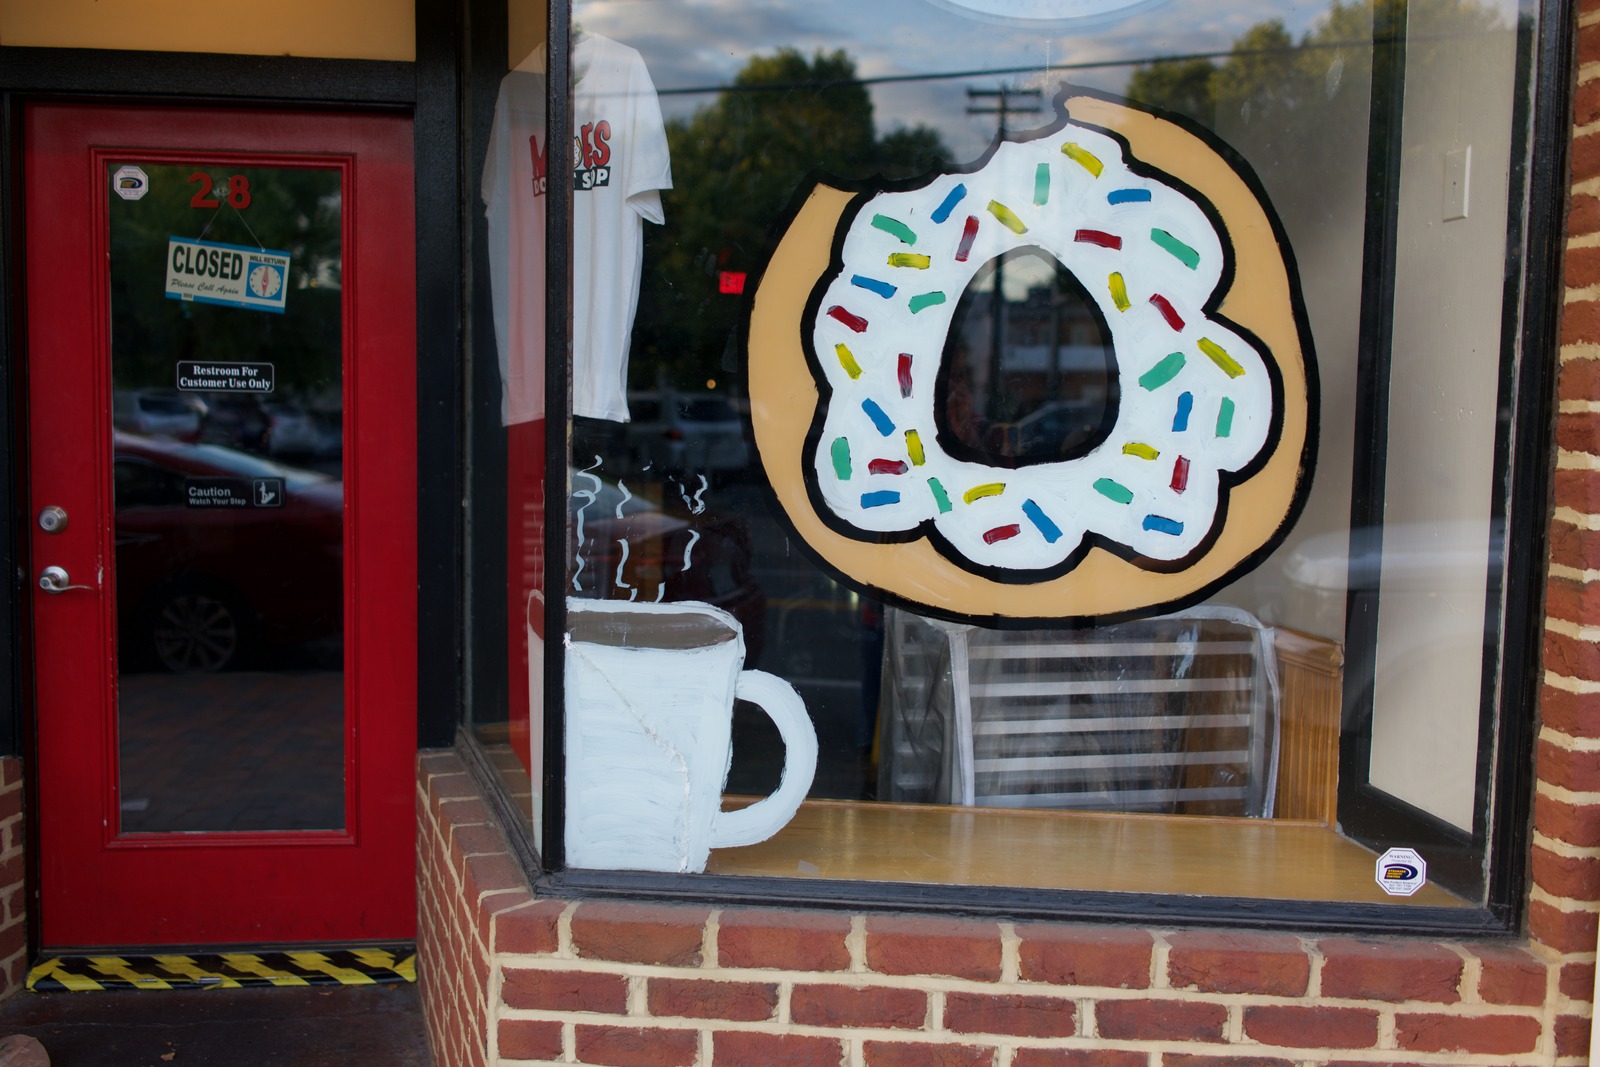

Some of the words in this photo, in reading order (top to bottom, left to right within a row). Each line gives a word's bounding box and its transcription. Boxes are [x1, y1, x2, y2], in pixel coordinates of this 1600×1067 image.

[173, 245, 243, 280] CLOSED
[264, 257, 286, 265] RETURN
[171, 279, 195, 289] Please
[198, 282, 215, 292] Call
[216, 285, 239, 295] Again
[193, 366, 240, 376] Restroom
[242, 367, 258, 376] For
[180, 376, 227, 388] Customer
[229, 379, 247, 388] Use
[248, 379, 271, 390] Only
[188, 487, 231, 497] Caution
[230, 498, 246, 506] Step
